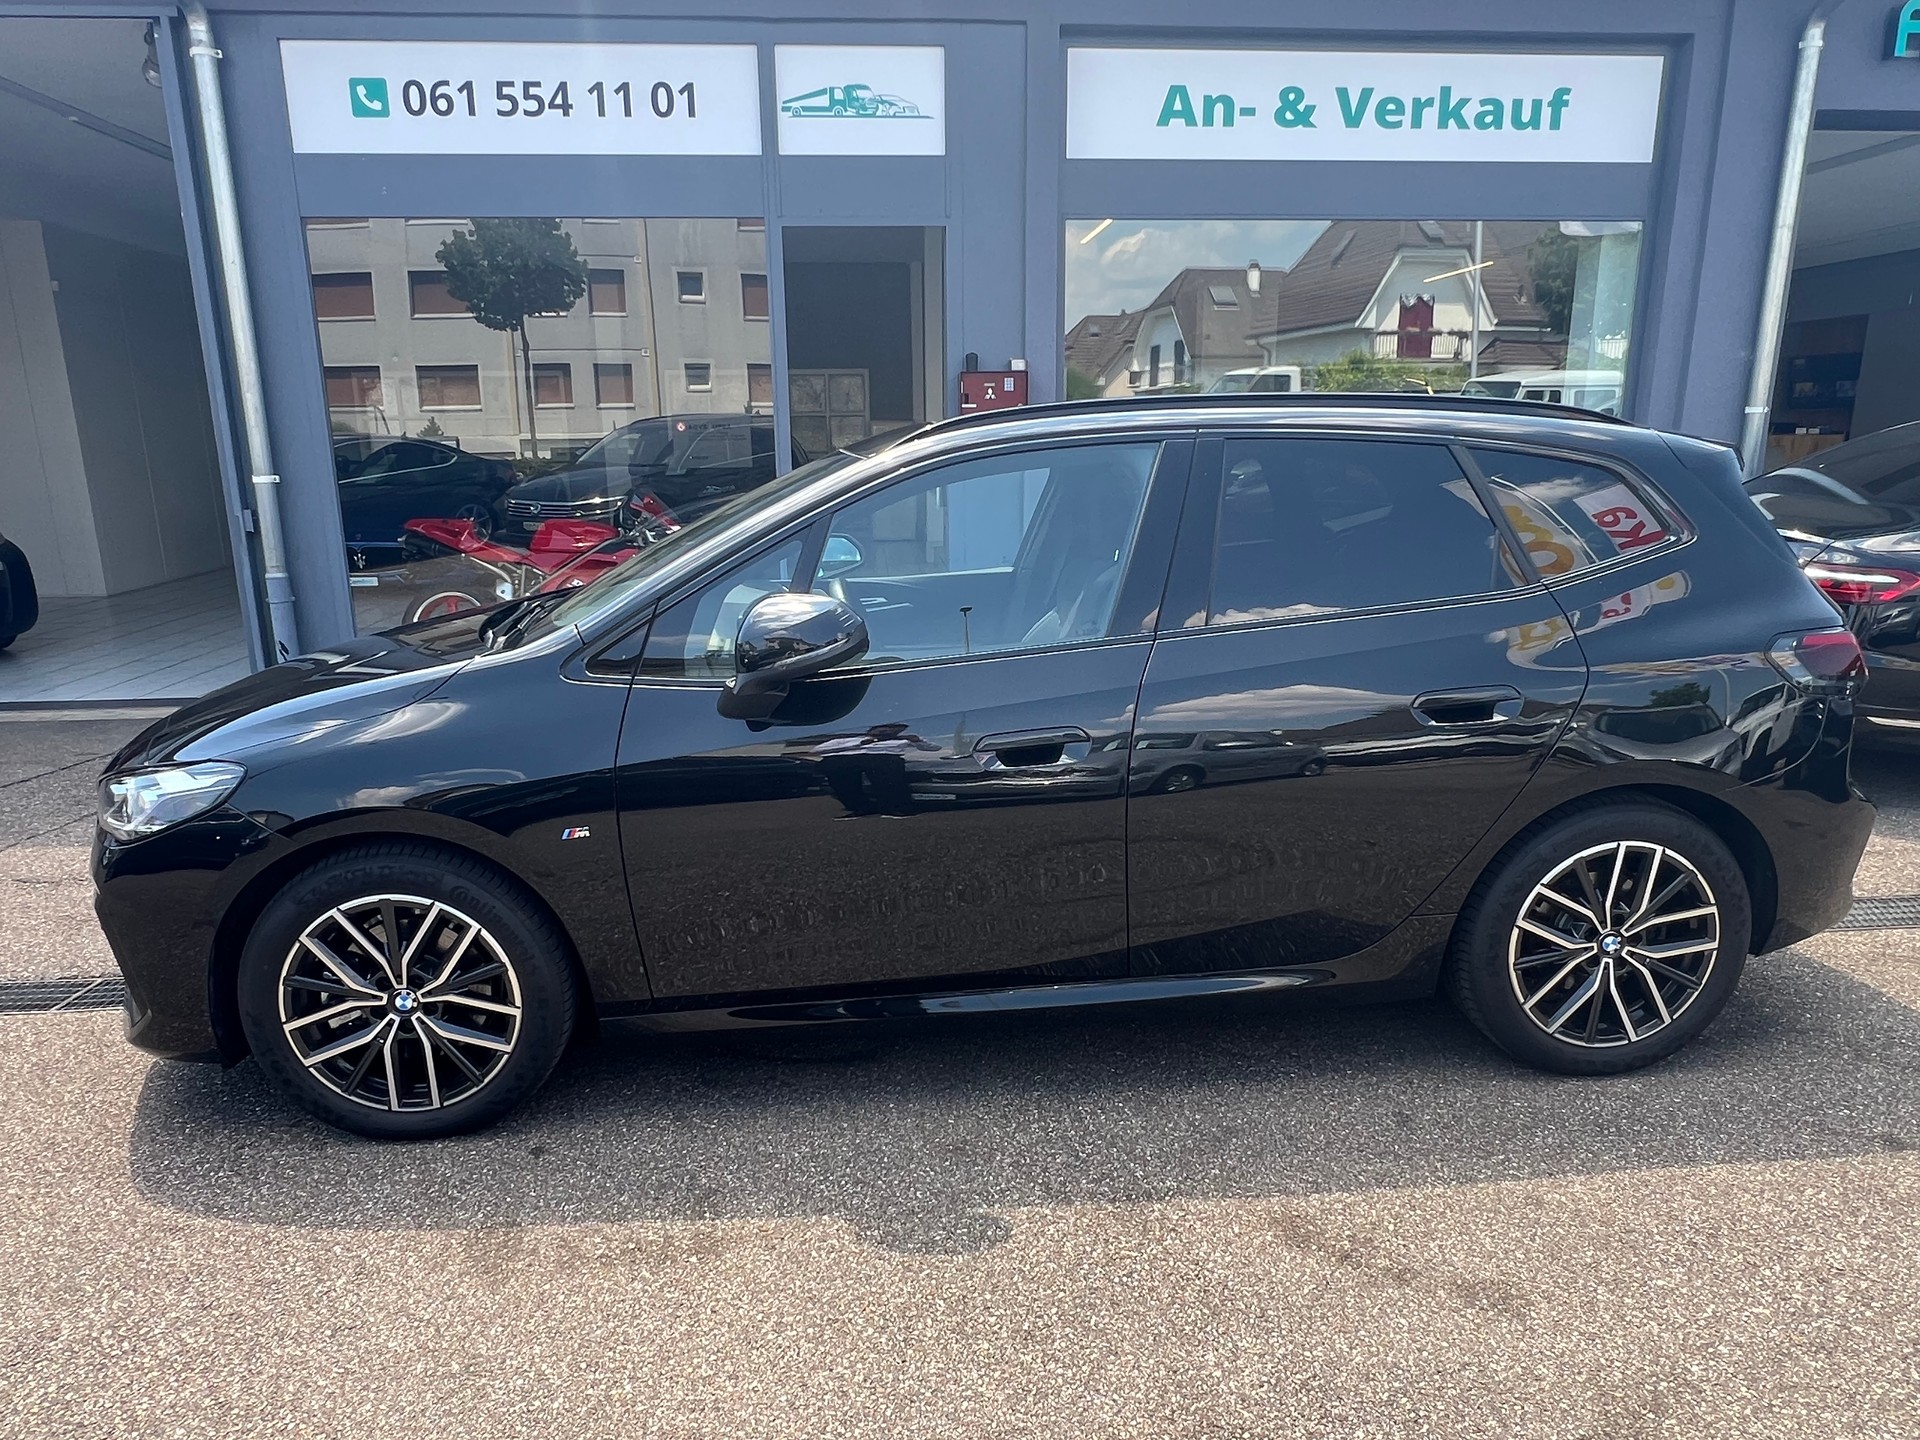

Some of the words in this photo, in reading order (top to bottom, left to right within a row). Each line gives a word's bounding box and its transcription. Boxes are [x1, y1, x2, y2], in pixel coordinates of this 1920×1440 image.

[402, 79, 477, 117] 061
[495, 80, 574, 118] 554
[588, 81, 632, 118] 11
[651, 81, 696, 118] 01
[1155, 84, 1257, 128] An-
[1273, 85, 1318, 129] &
[1334, 85, 1573, 131] Verkauf
